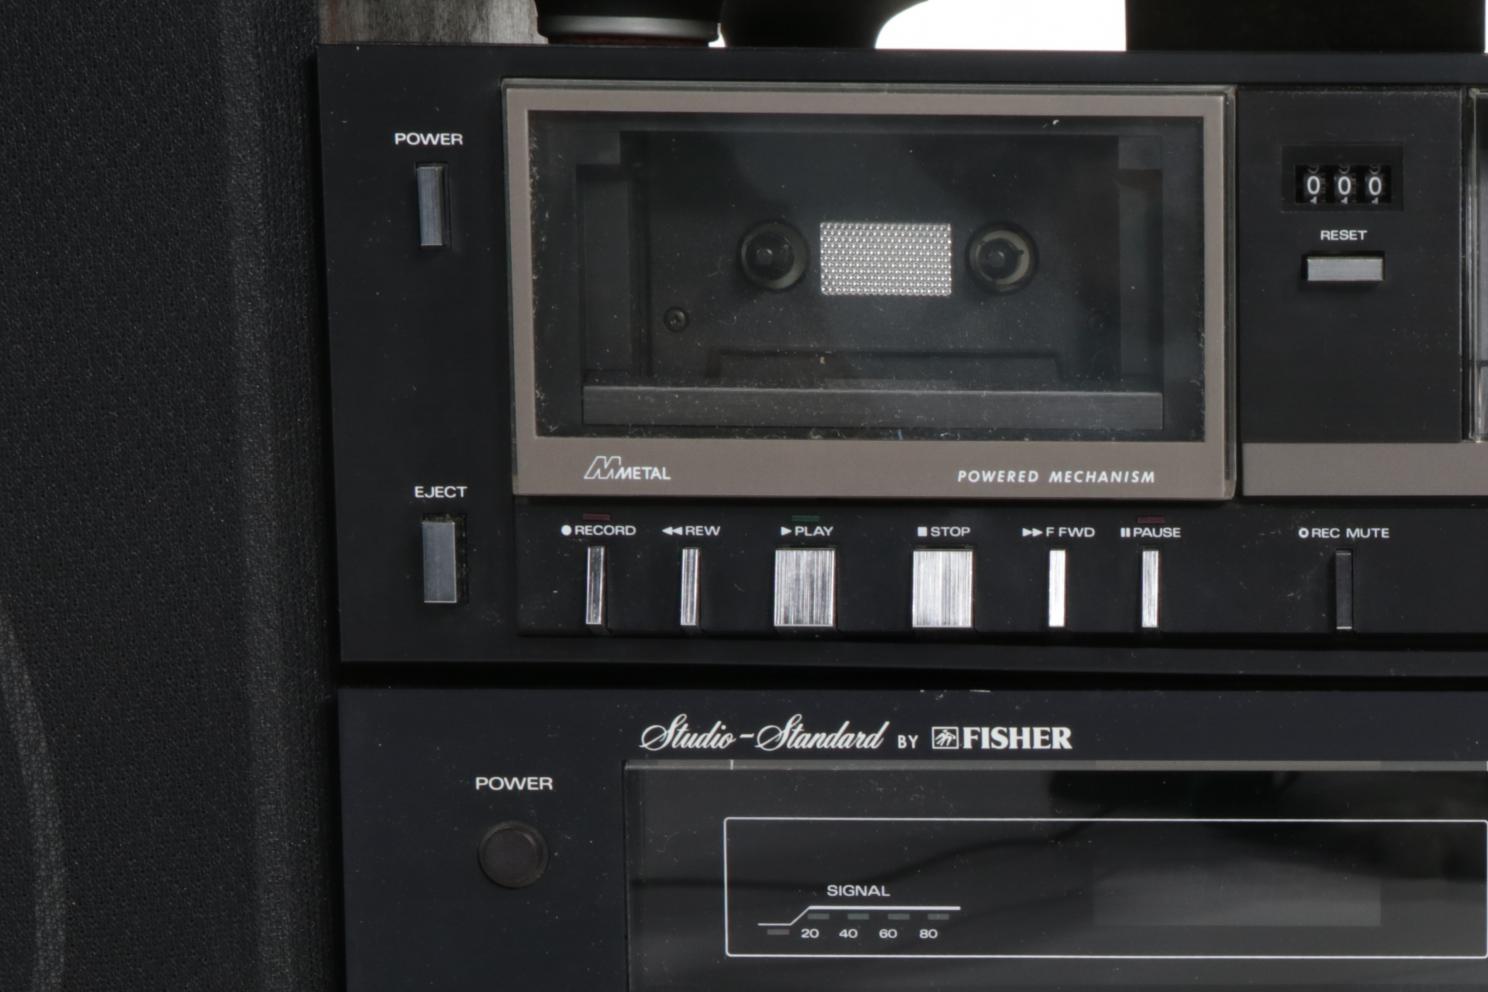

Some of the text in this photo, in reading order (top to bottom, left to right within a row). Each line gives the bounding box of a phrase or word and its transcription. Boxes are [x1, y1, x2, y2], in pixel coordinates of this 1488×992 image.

[395, 133, 463, 145] POWER
[1321, 230, 1367, 240] RESET
[958, 471, 1154, 483] POWERED MECHANISM
[415, 486, 467, 498] EJECT
[575, 525, 636, 535] RECORD
[685, 526, 720, 536] REW
[795, 526, 833, 536] PLAY
[931, 527, 970, 537] STOP
[1046, 527, 1095, 537] F FWD
[1133, 527, 1180, 537] PAUSE
[1312, 528, 1389, 538] REC MUTE
[898, 735, 918, 748] BY
[963, 727, 1072, 749] FISHER
[476, 777, 552, 790] POWER
[827, 885, 890, 896] SIGNAL
[801, 929, 938, 938] 20 40 60 80
